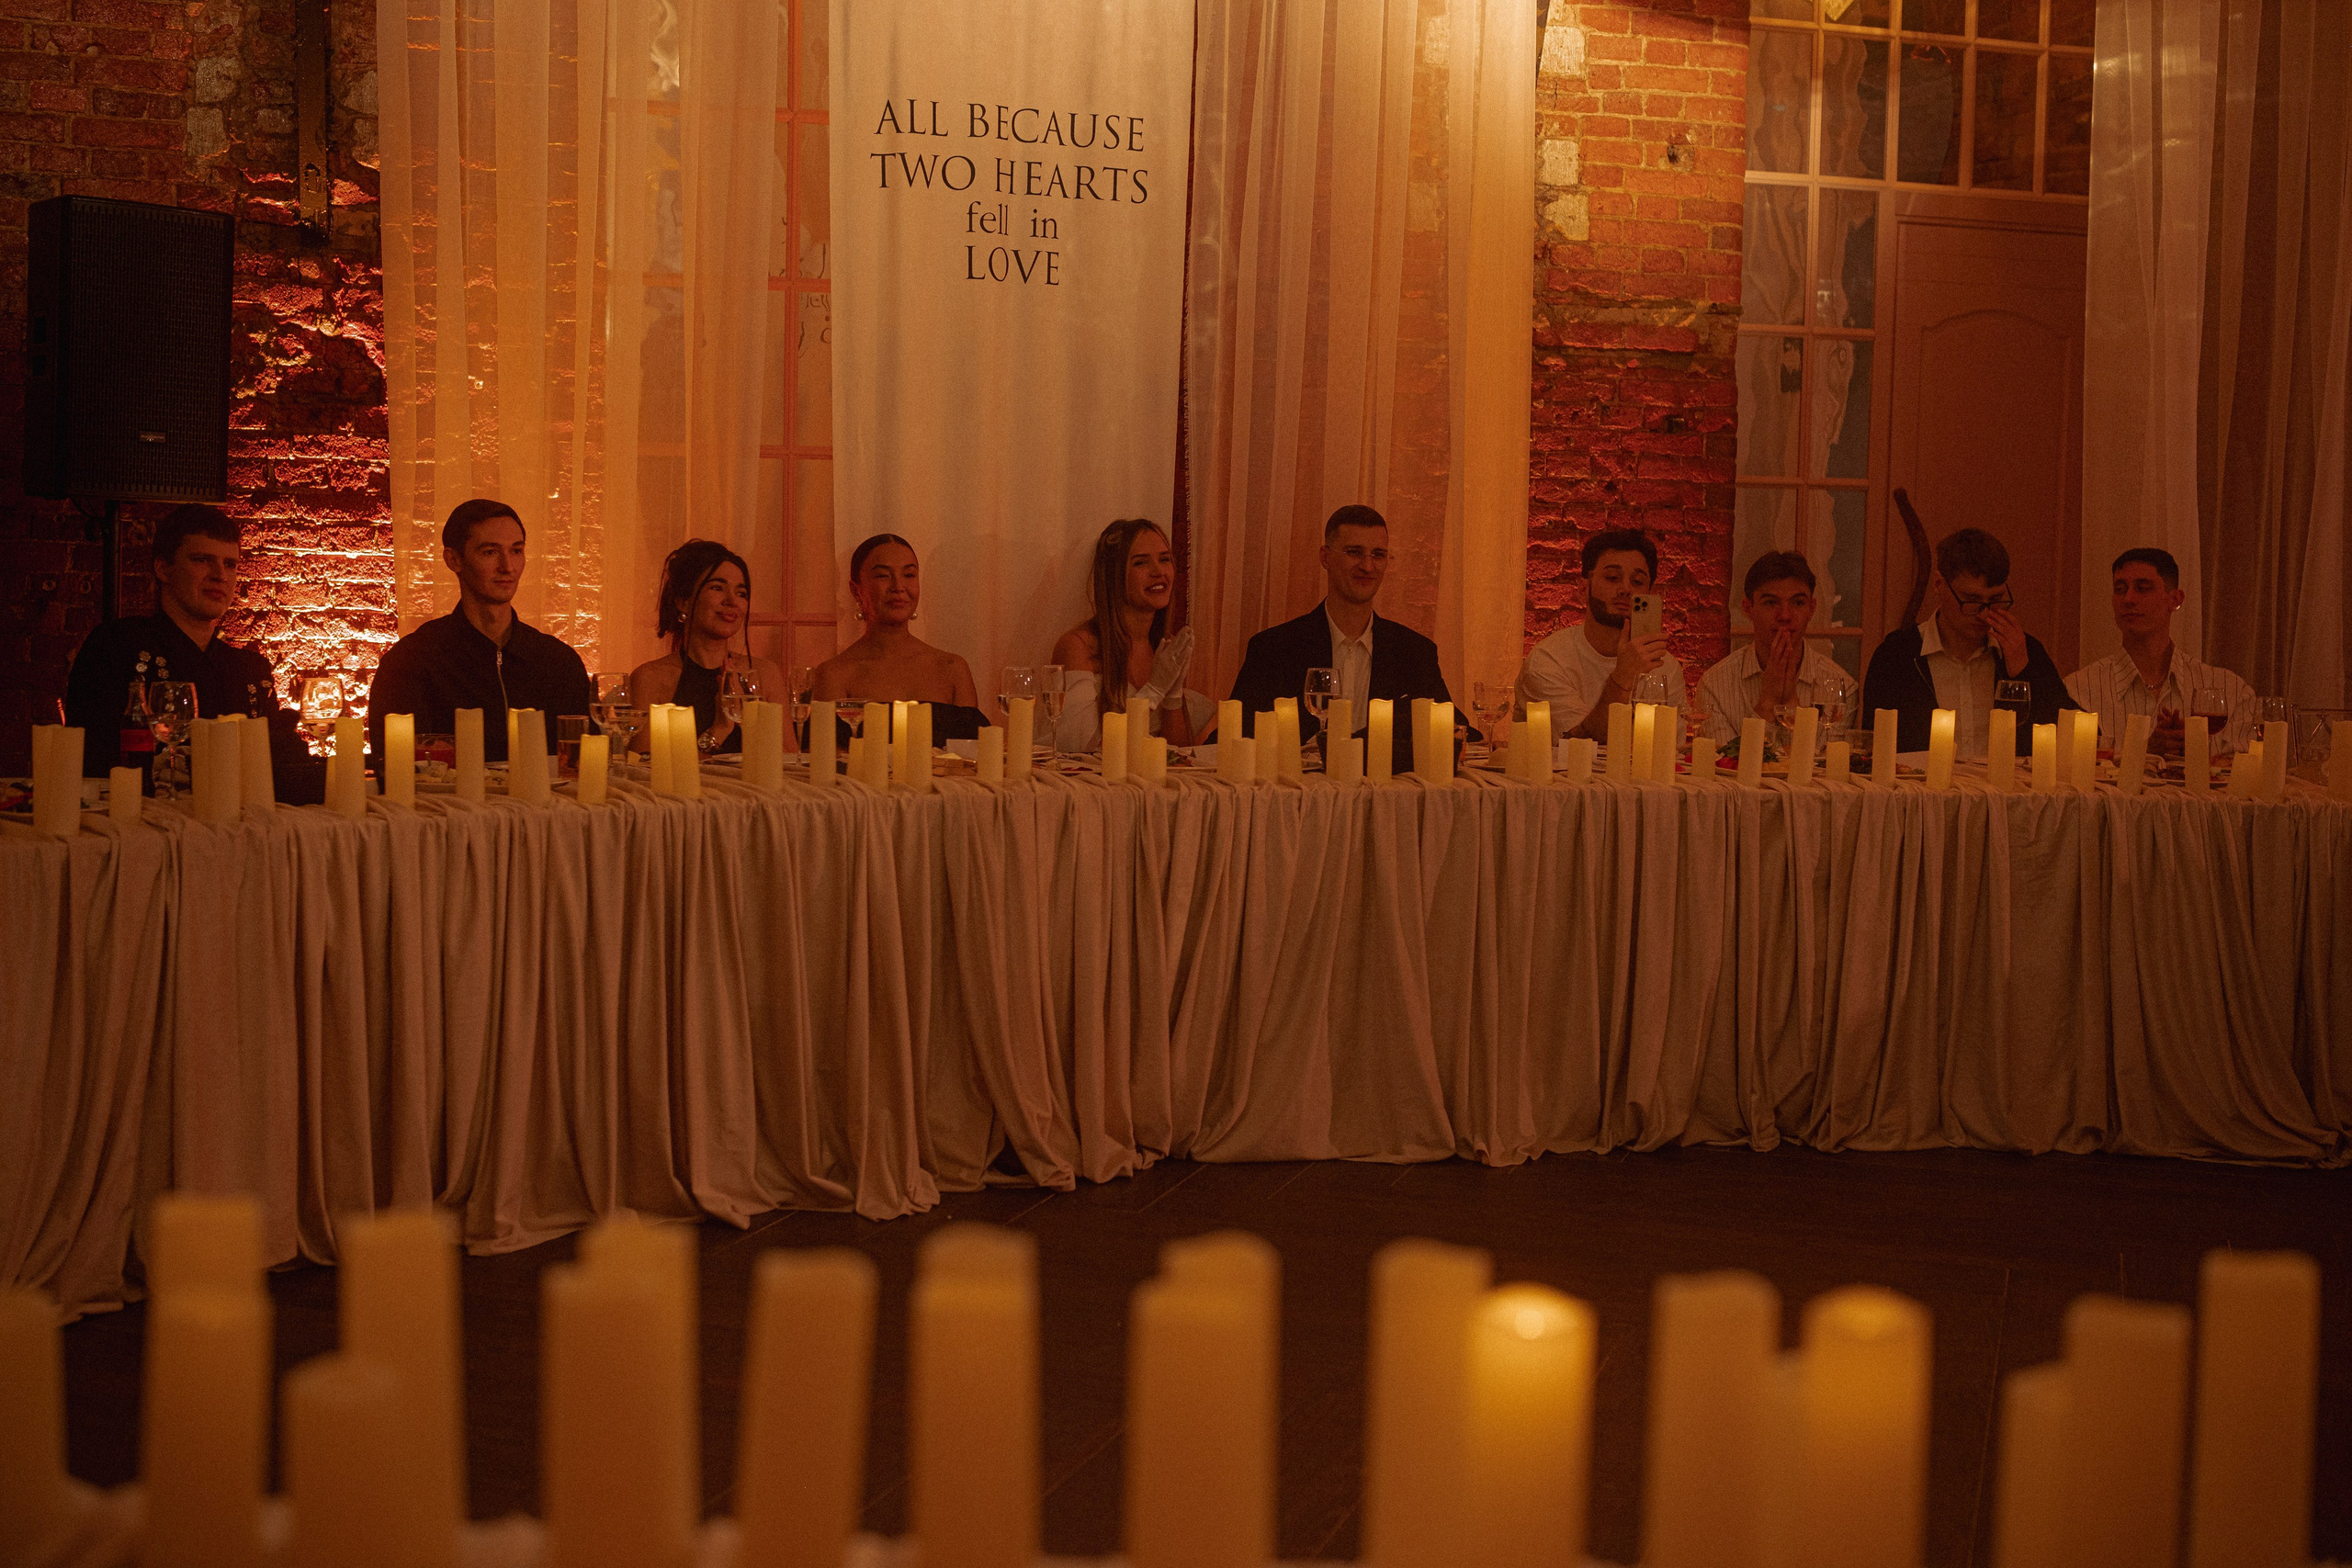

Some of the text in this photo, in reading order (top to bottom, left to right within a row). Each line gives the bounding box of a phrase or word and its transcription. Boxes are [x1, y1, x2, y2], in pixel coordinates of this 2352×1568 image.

[873, 98, 1145, 152] ALL BECAUSE
[870, 152, 1148, 204] TWO HEARTS
[966, 200, 1058, 240] fell in
[965, 245, 1059, 286] LOVE
